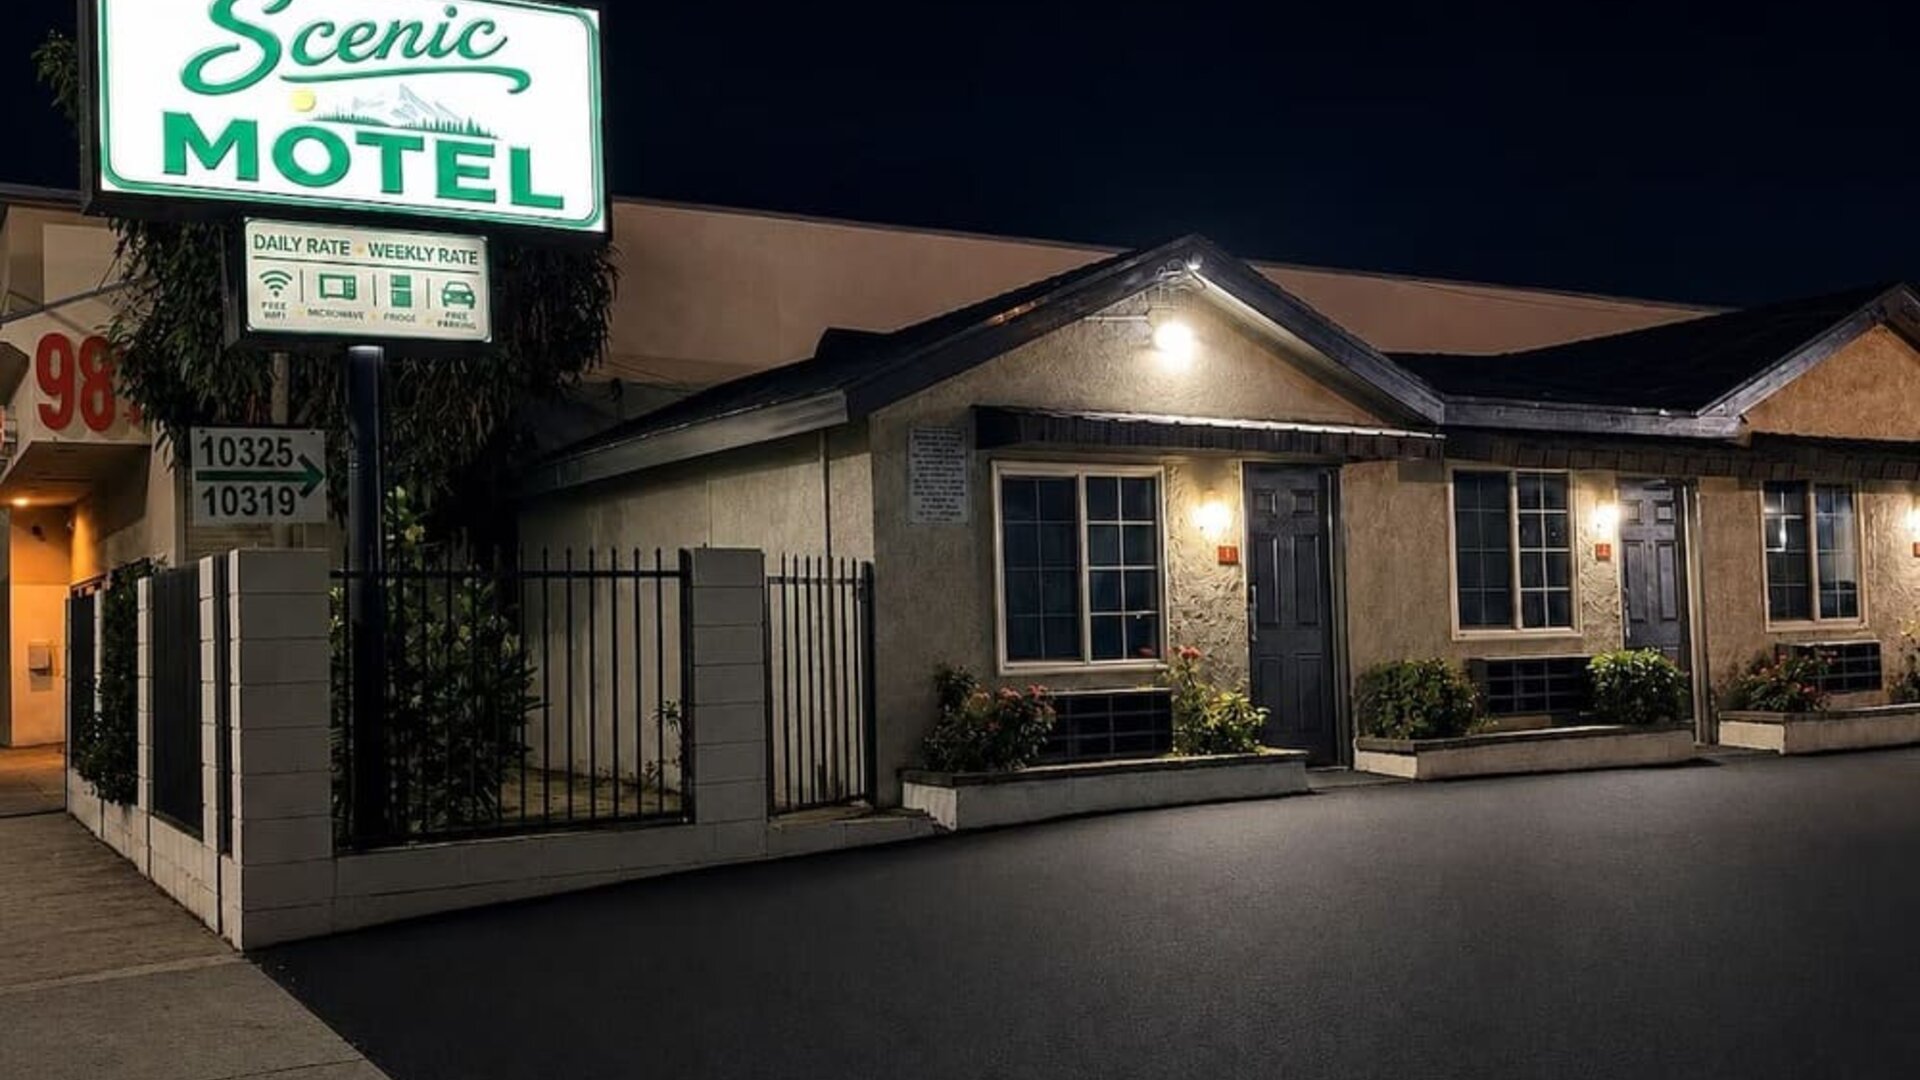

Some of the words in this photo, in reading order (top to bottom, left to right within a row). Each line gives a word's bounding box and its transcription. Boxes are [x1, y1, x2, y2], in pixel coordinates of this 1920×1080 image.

[180, 0, 508, 95] Scenic
[162, 111, 564, 210] MOTEL
[253, 234, 302, 252] DAILY
[306, 238, 350, 256] RATE
[368, 242, 435, 263] WEEKLY
[438, 248, 478, 265] RATE
[261, 301, 287, 310] FREE
[307, 308, 364, 320] MICROWAVE
[445, 311, 468, 320] FREE
[383, 312, 416, 323] FRIDGE
[437, 320, 477, 330] PARKING
[201, 436, 293, 468] 10325
[203, 486, 295, 516] 10319
